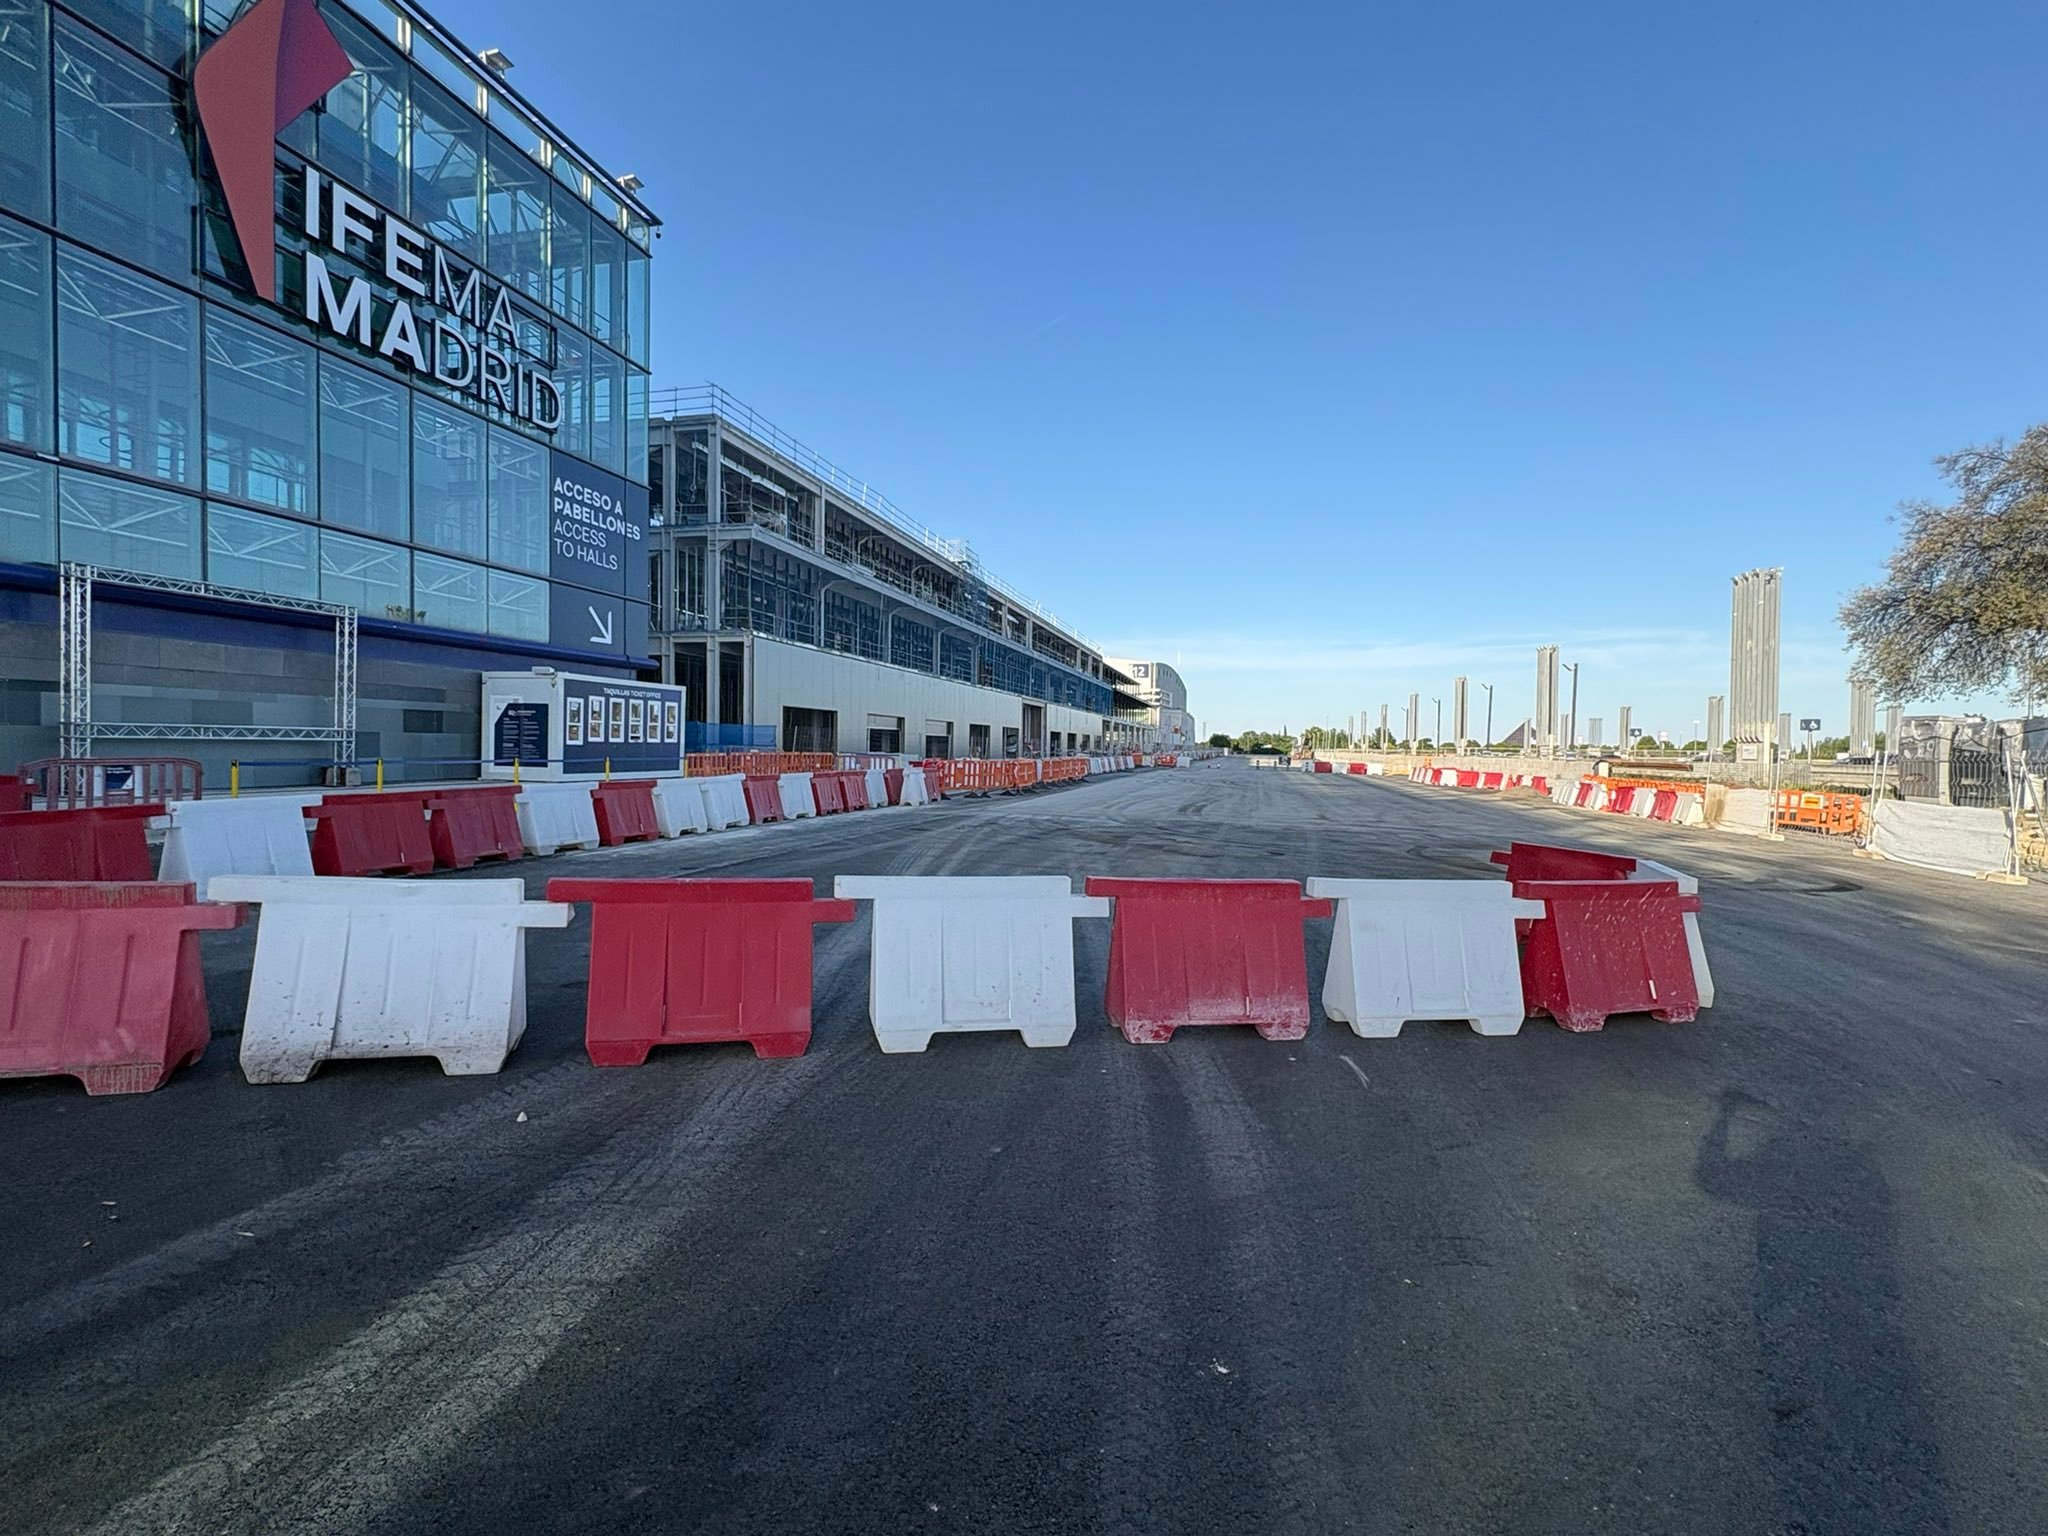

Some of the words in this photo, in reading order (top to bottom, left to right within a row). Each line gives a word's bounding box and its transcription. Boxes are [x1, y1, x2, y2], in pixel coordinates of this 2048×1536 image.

[305, 167, 520, 348] IFEMA
[305, 254, 563, 430] MADRID
[553, 477, 611, 511] ACCESO
[614, 500, 624, 516] A
[553, 497, 641, 540] PABELLONES
[553, 518, 607, 548] ACCESS
[553, 538, 574, 558] TO
[577, 544, 618, 570] HALLS
[1133, 666, 1145, 677] 12
